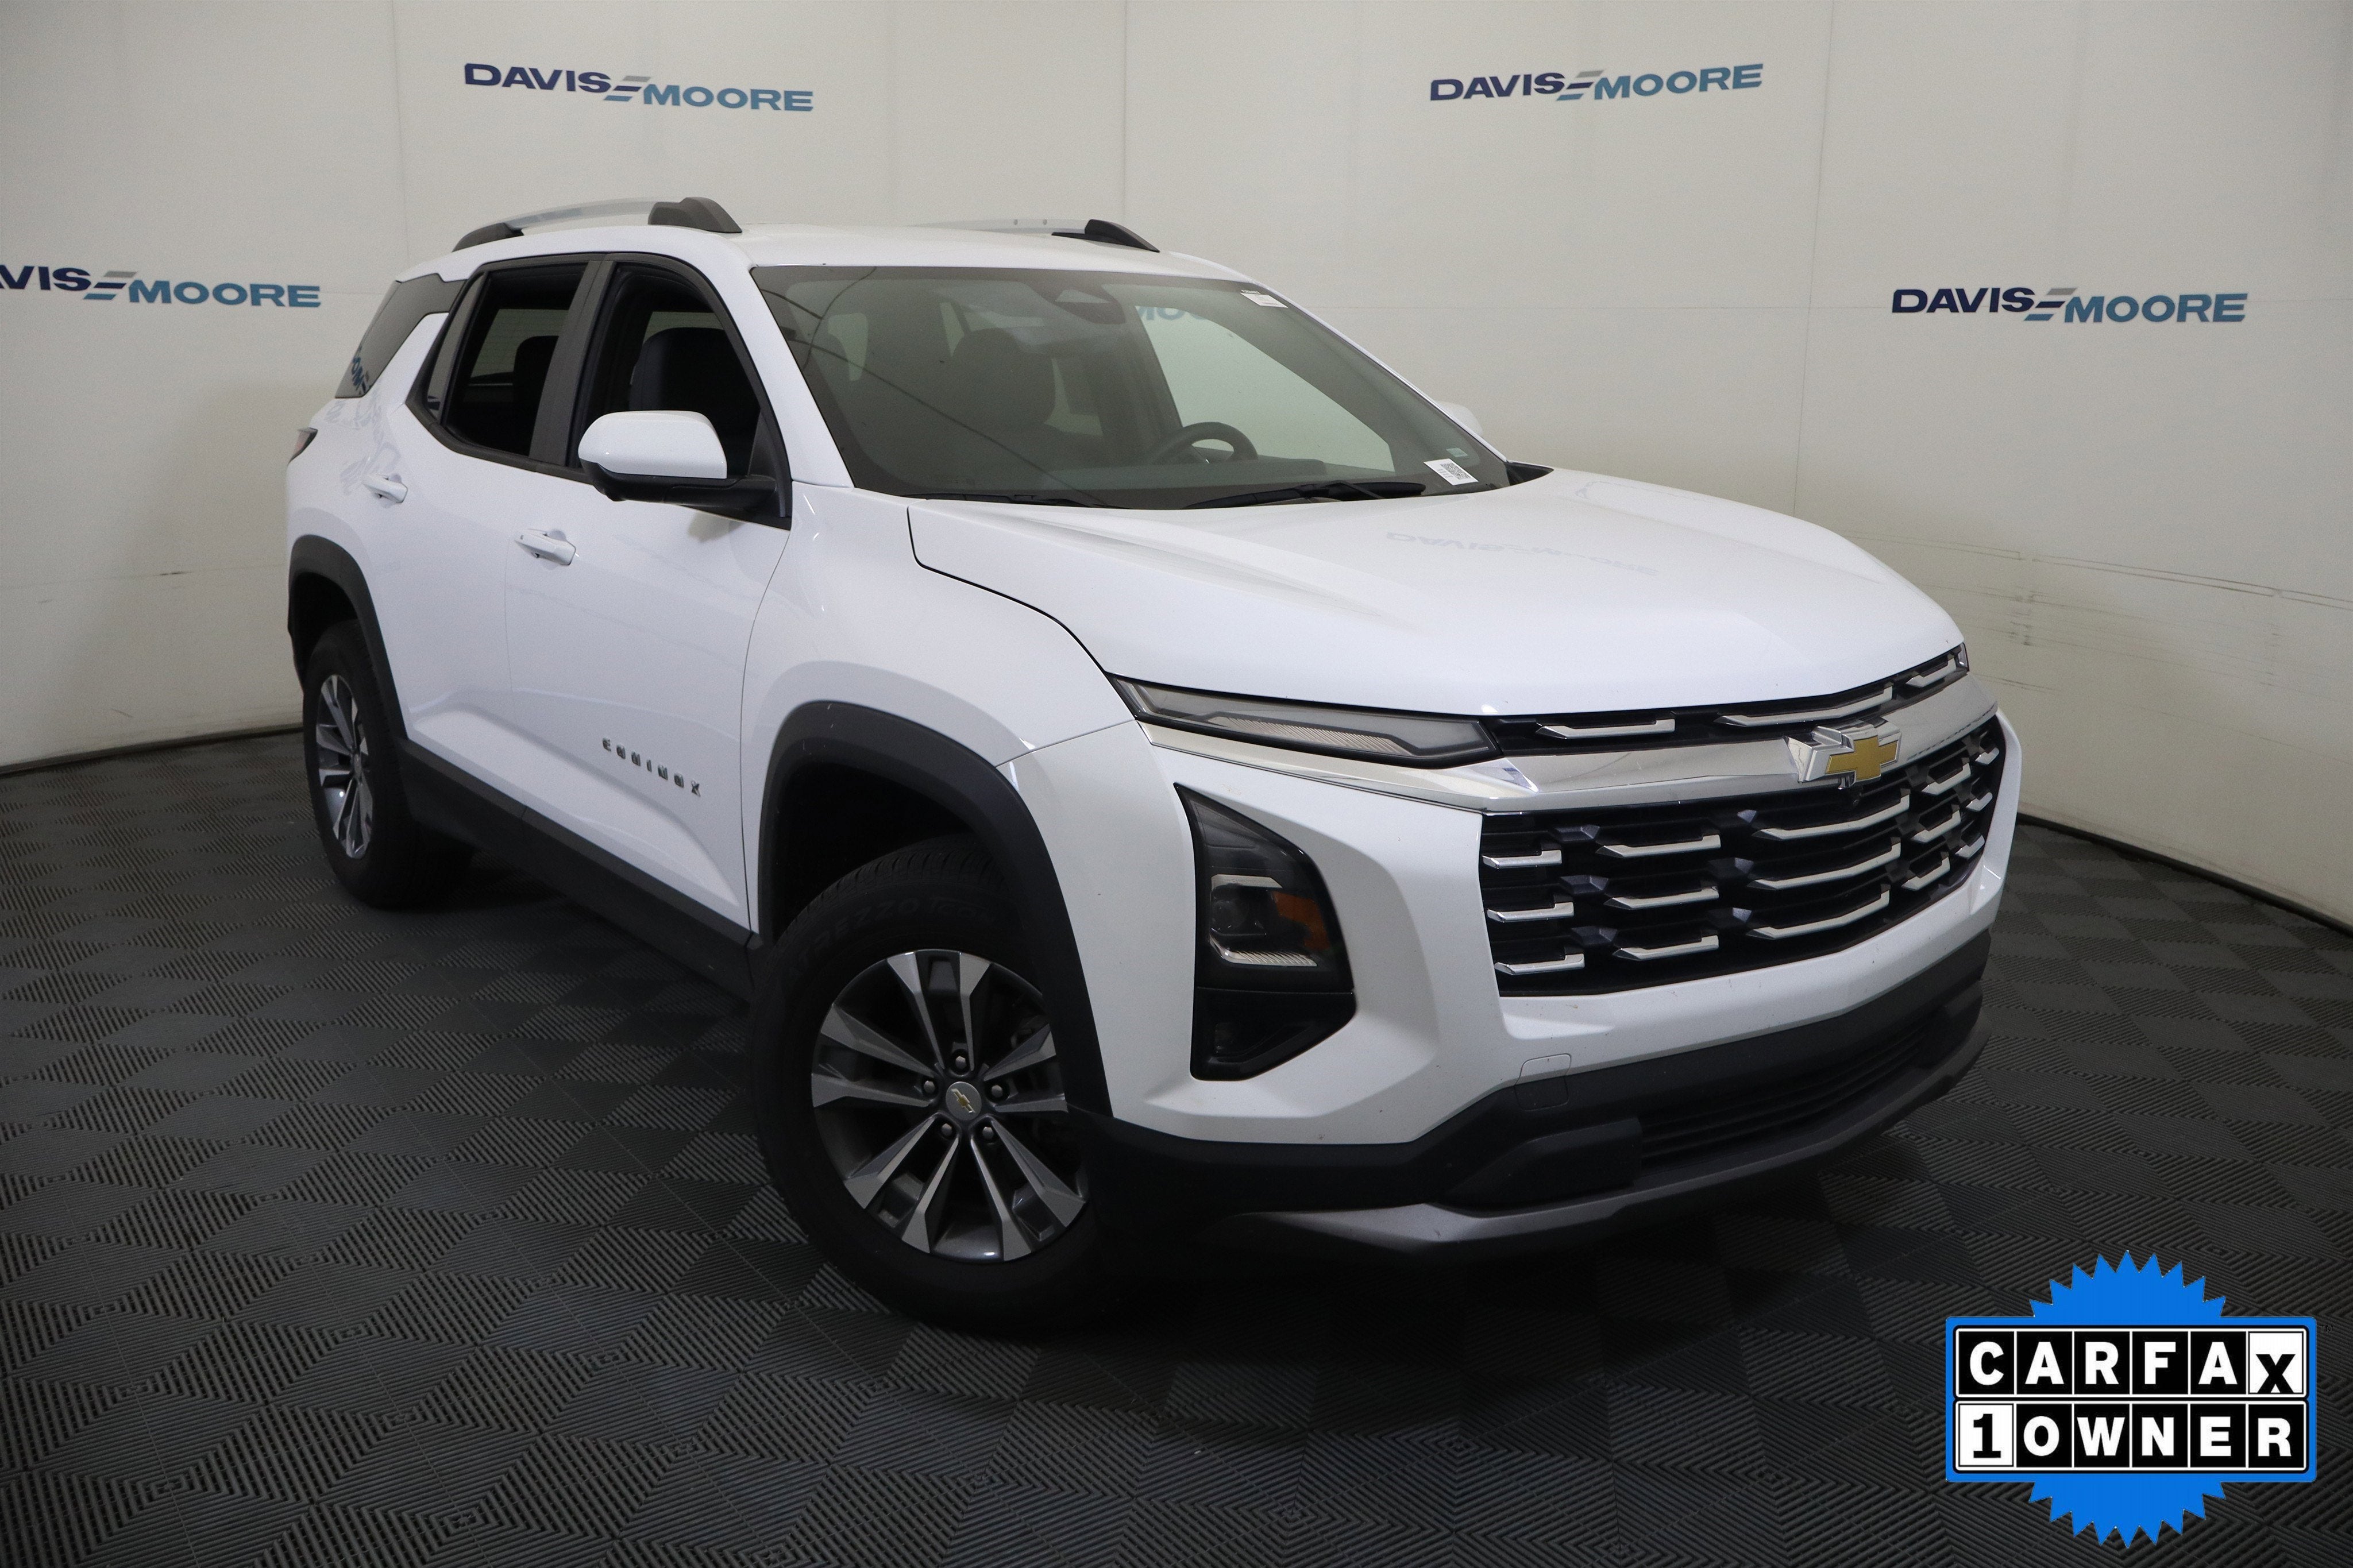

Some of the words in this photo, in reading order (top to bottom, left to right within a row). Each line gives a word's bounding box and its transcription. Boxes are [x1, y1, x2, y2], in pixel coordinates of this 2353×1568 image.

[464, 63, 611, 93] DAVIS
[643, 84, 813, 111] MOORE
[1430, 74, 1564, 101] DAVIS
[1594, 64, 1763, 100] MOORE
[0, 264, 91, 291] VIS
[128, 279, 321, 308] MOORE
[1892, 287, 2035, 312] DAVIS
[2065, 293, 2248, 323] MOORE
[602, 737, 701, 797] EQUINOX
